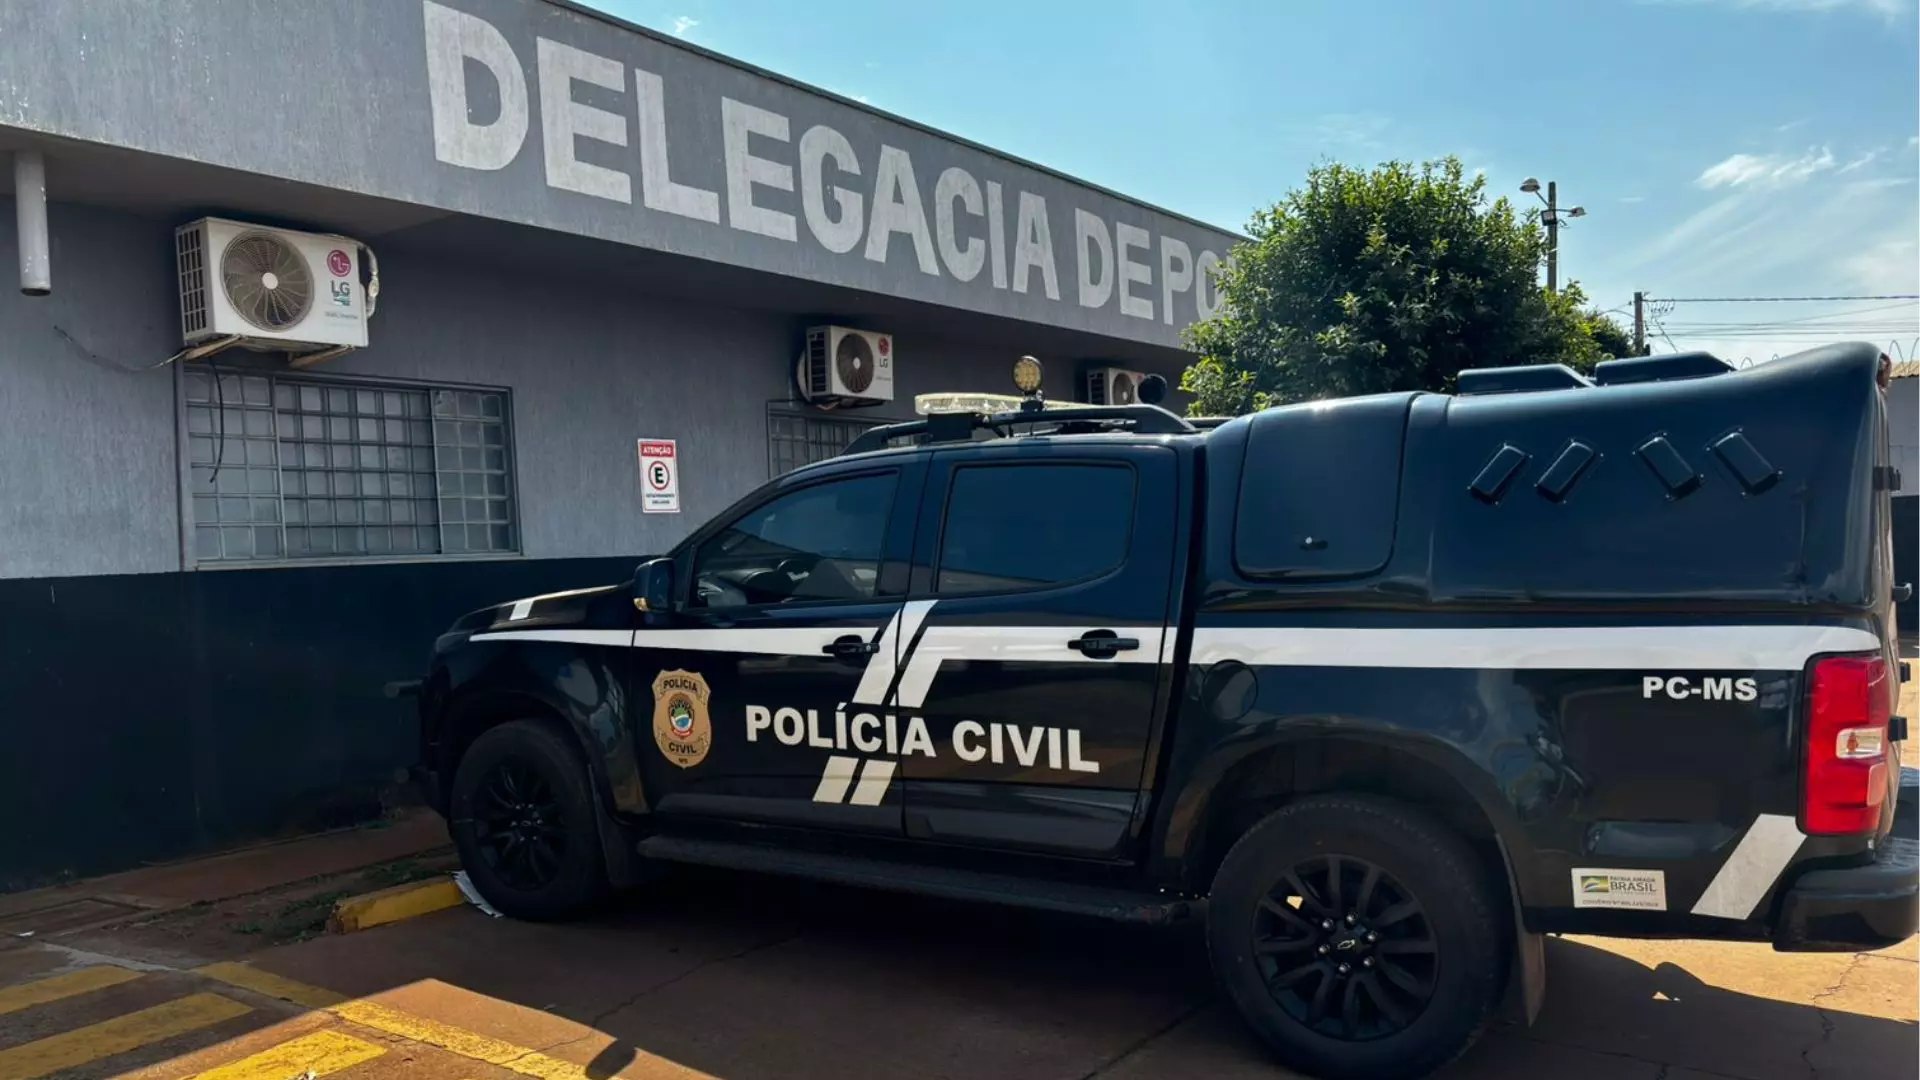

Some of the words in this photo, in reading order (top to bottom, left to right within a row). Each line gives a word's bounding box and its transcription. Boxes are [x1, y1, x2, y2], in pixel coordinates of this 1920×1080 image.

[423, 0, 1059, 301] DELEGACIA
[1075, 207, 1154, 320] DE
[1160, 235, 1237, 326] PO
[331, 280, 350, 297] LG
[642, 446, 672, 455] ATENÇÃO
[654, 467, 664, 483] E
[663, 677, 698, 692] POLÍCIA
[1643, 676, 1757, 701] PC-MS
[746, 702, 937, 757] POLÍCIA
[952, 720, 1100, 773] CIVIL
[668, 742, 697, 754] CIVIL
[1610, 881, 1657, 892] BRASIL
